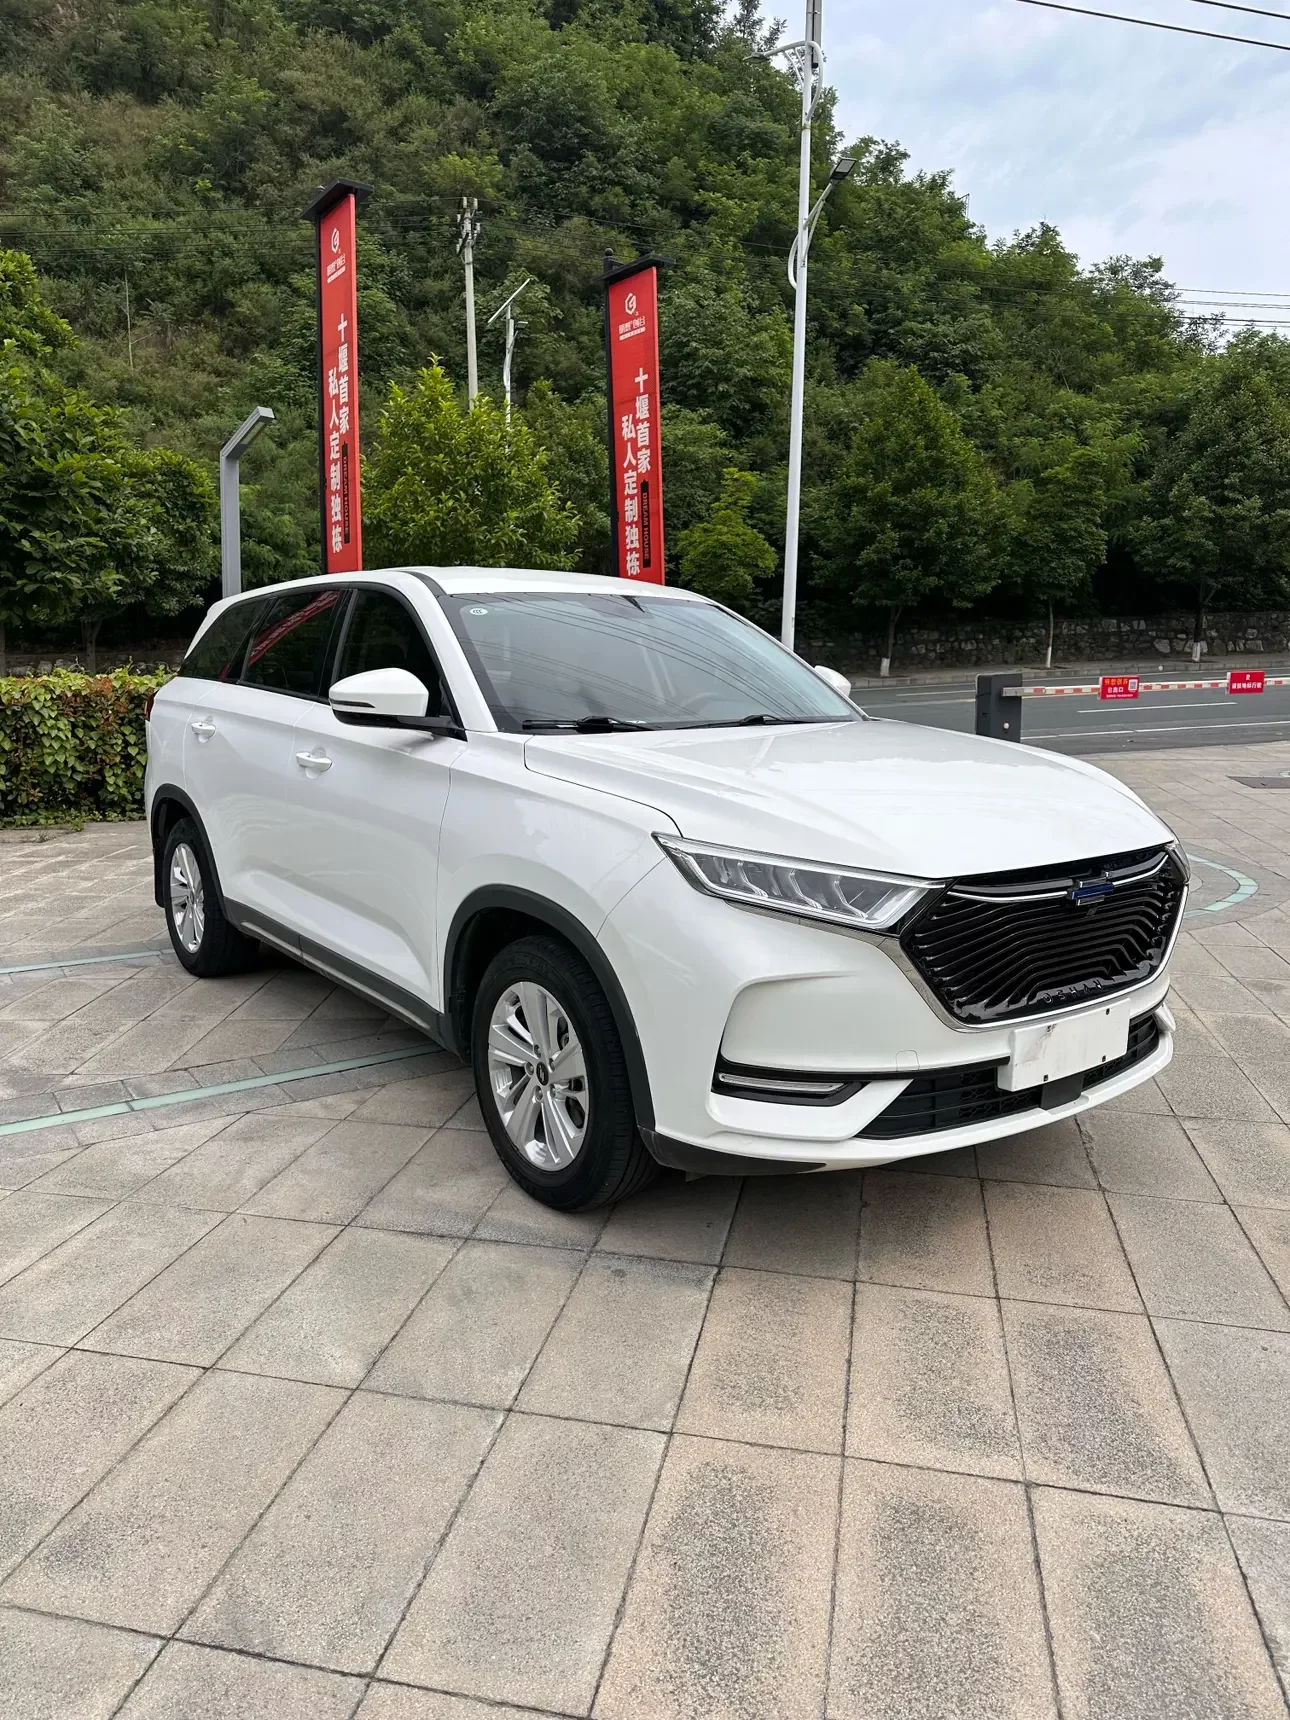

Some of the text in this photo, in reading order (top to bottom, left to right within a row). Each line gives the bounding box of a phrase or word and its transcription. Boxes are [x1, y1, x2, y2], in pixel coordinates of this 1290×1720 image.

[337, 313, 349, 434] 十堰首家
[634, 367, 651, 474] 十堰首家
[328, 367, 342, 554] 私人定制独栋
[621, 413, 640, 577] 私人定制独栋
[1043, 979, 1102, 1003] OSHAN
